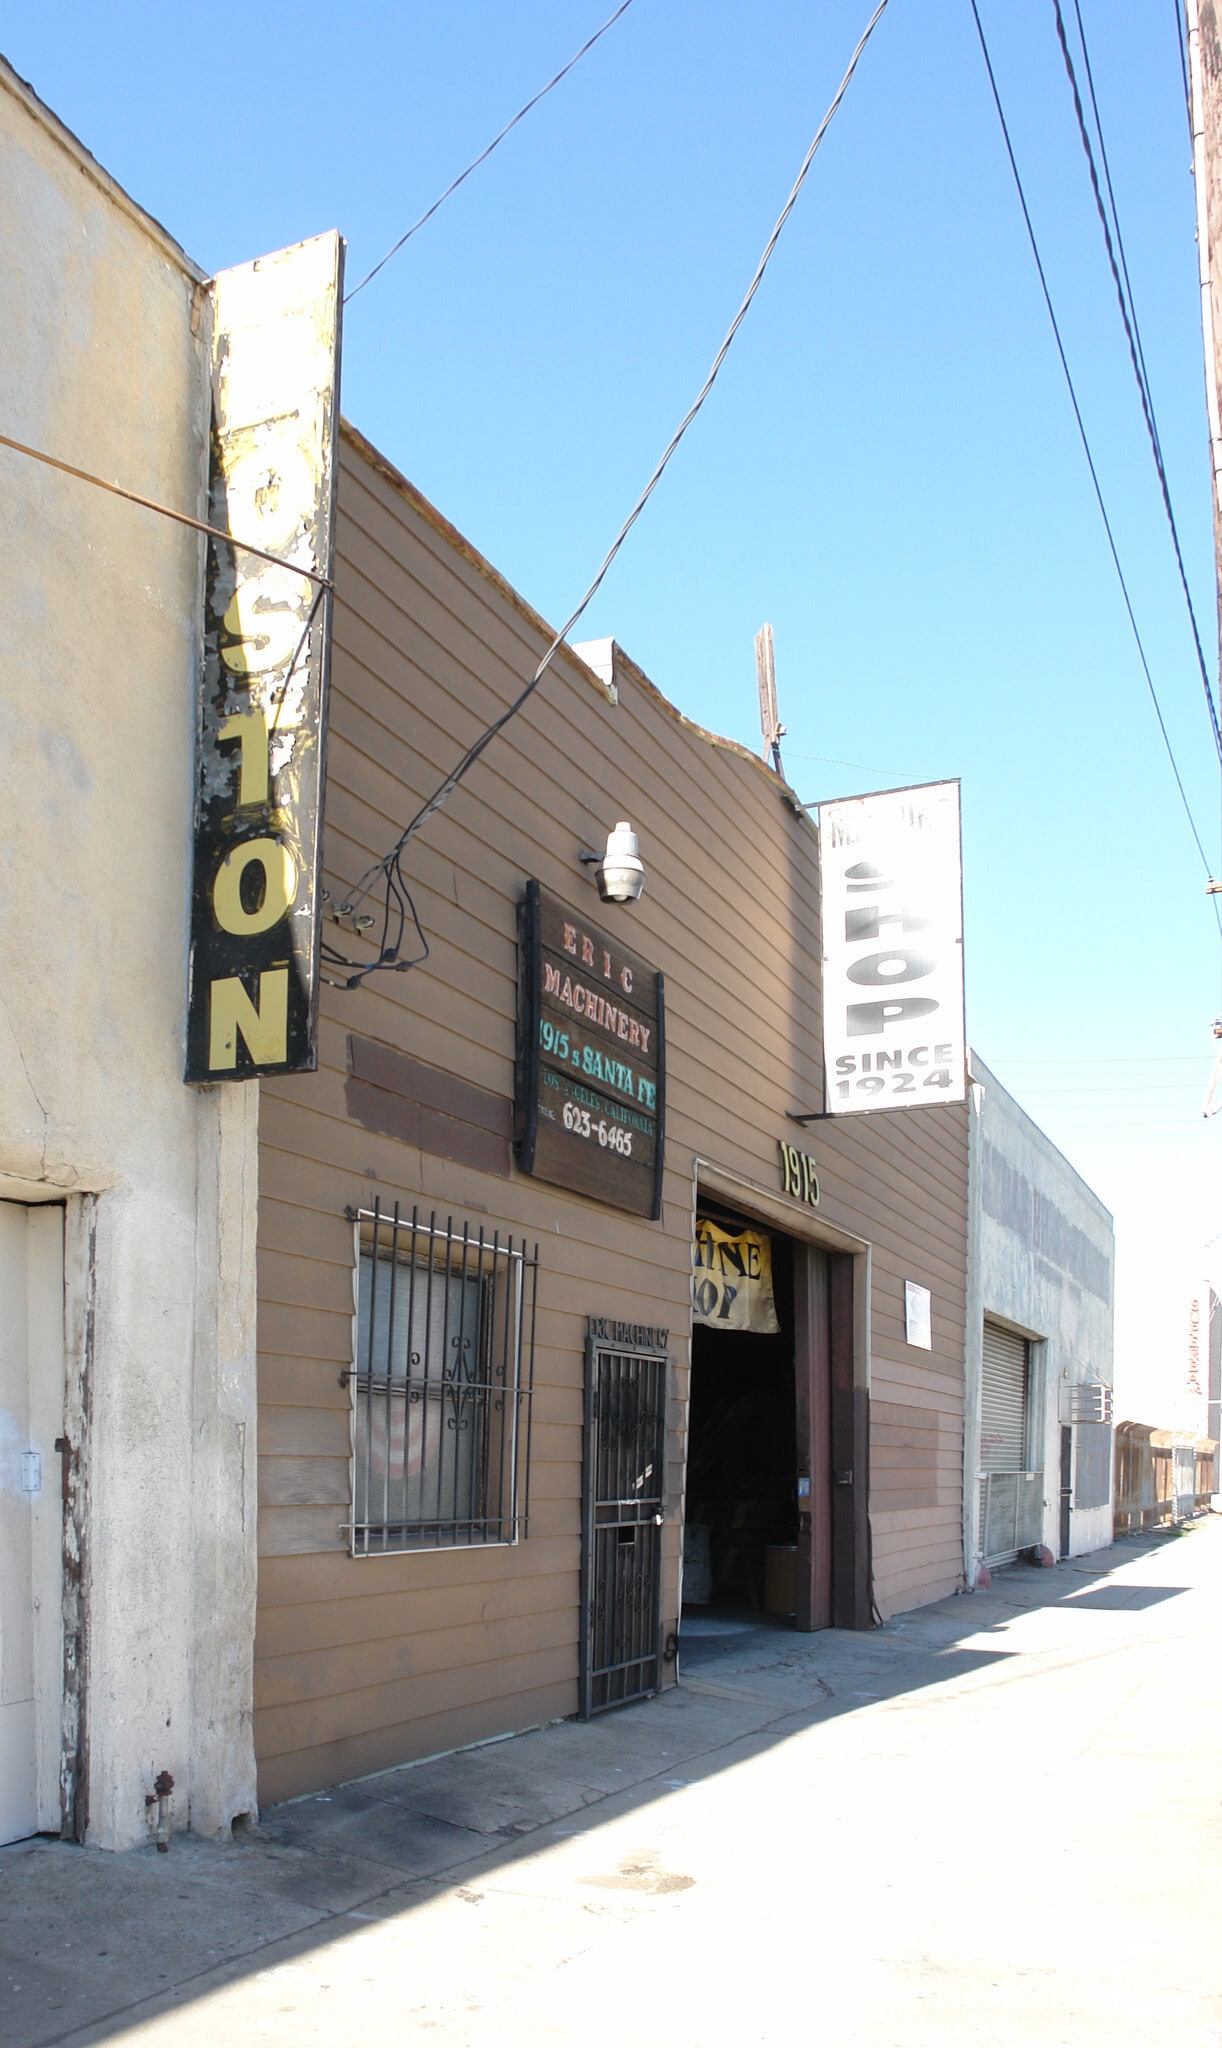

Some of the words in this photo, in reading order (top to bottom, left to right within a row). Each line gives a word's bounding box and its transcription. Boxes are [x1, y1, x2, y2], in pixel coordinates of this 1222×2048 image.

[564, 922, 633, 993] ERIC
[544, 963, 651, 1053] MACHINERY
[539, 1019, 570, 1060] 1915
[582, 1045, 635, 1097] SANTA
[637, 1077, 657, 1111] FE
[835, 1043, 954, 1076] SINCE
[836, 1068, 954, 1099] 1924
[562, 1101, 634, 1157] 623-6465
[781, 1140, 821, 1208] 1915
[693, 1275, 738, 1319] OP
